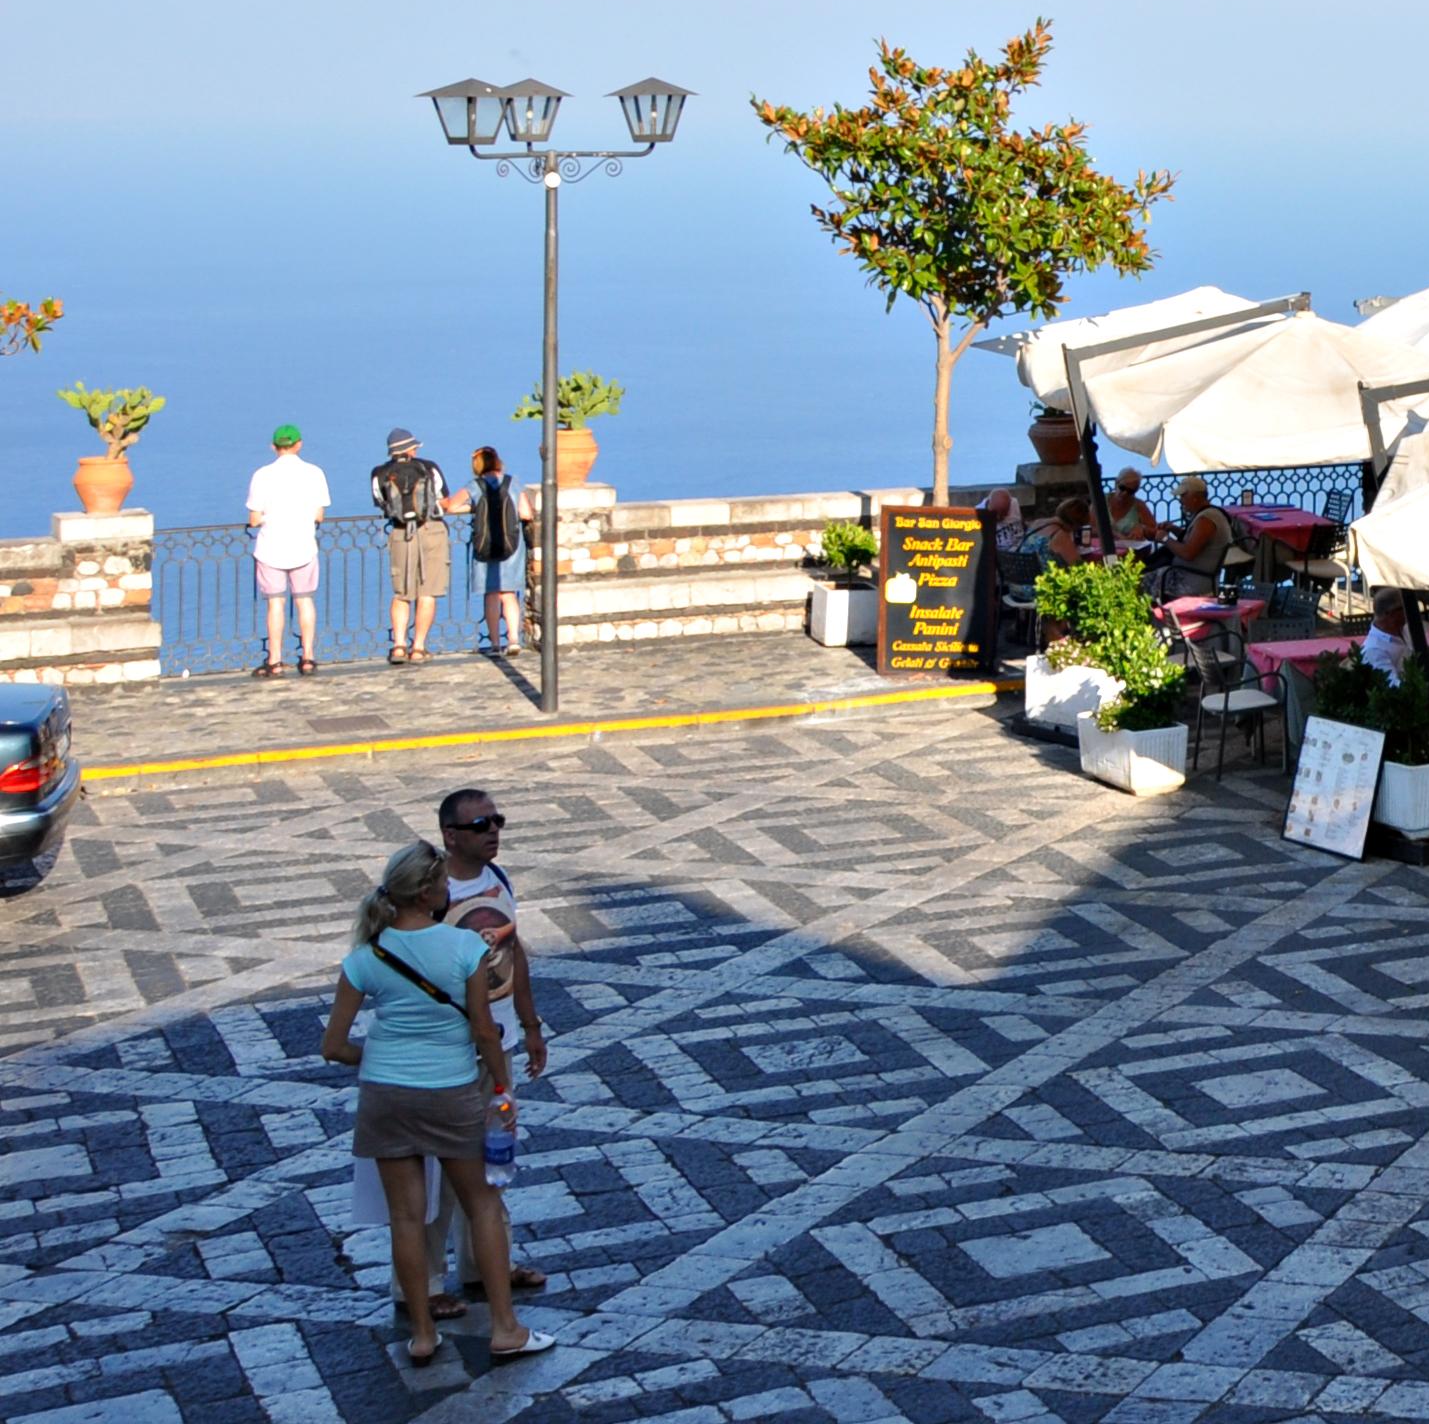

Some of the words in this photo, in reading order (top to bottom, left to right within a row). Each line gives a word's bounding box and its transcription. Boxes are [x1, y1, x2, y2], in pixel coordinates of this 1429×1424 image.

[895, 516, 916, 528] Bar
[918, 517, 940, 528] San
[942, 518, 982, 532] Giorgio
[902, 537, 944, 551] Snack
[945, 537, 974, 551] Bar
[908, 553, 969, 570] Antipasti
[918, 572, 958, 587] Pizza
[909, 605, 964, 619] Insalate
[913, 621, 960, 635] Panini
